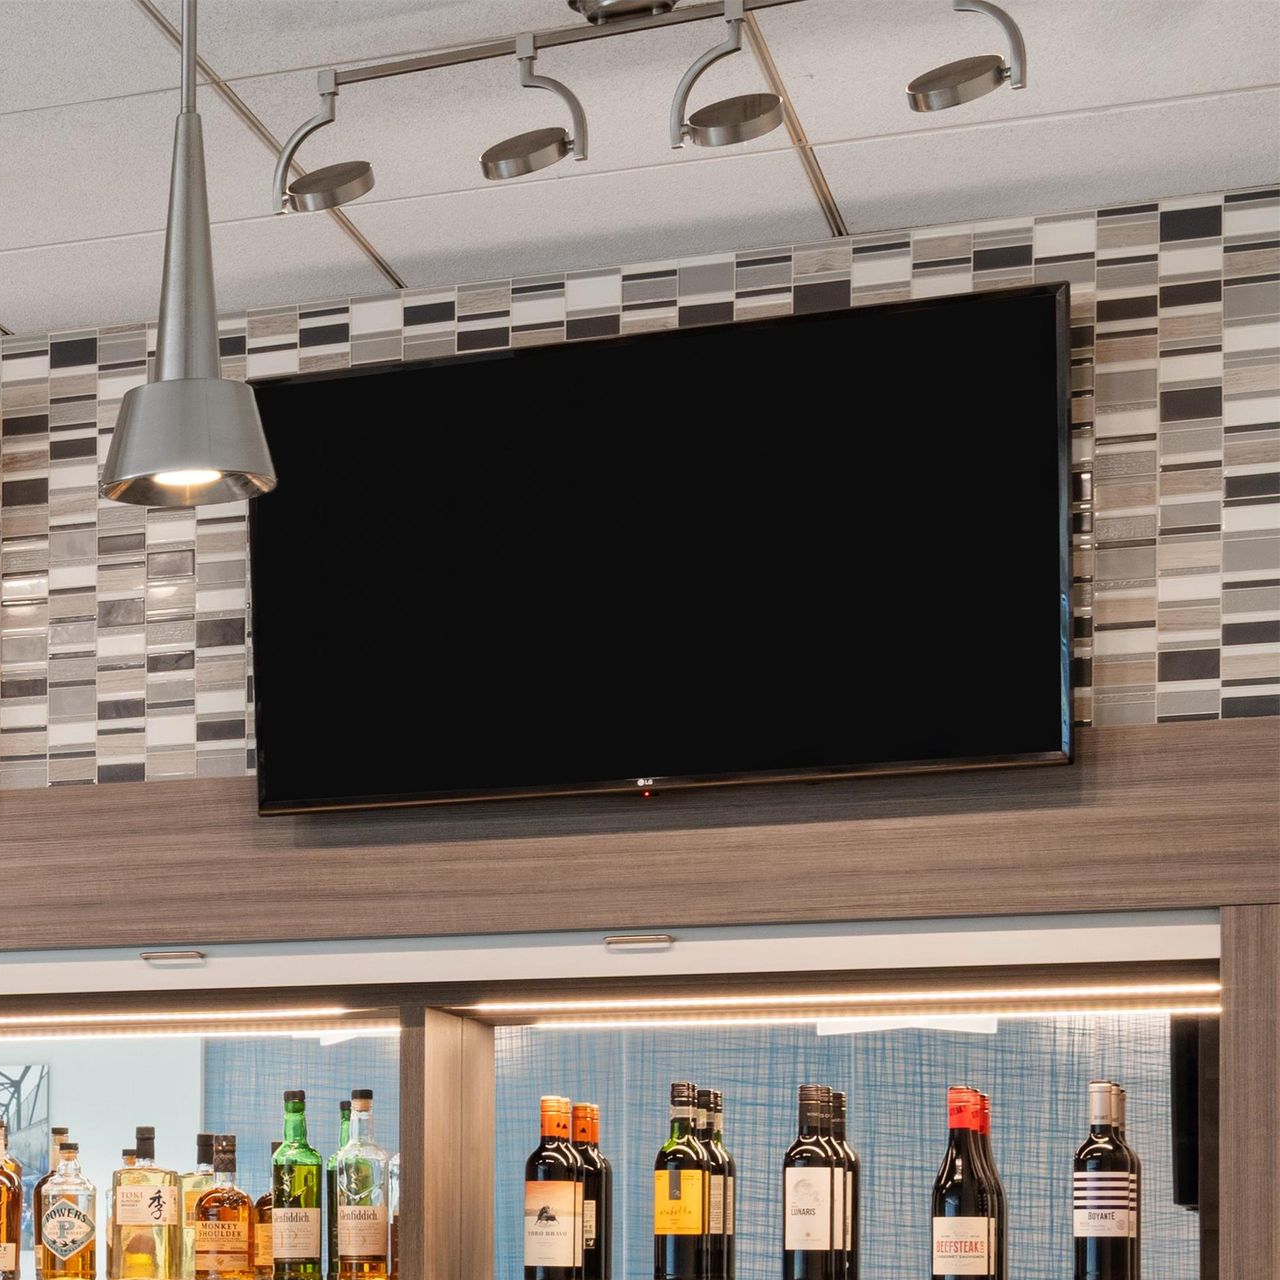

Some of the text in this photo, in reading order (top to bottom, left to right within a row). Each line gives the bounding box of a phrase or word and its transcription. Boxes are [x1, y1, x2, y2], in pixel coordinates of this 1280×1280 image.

[120, 1191, 143, 1199] TOKI
[45, 1207, 88, 1223] POWERS
[790, 1207, 816, 1216] LUNARIS
[201, 1222, 238, 1230] MONKEY
[198, 1230, 241, 1238] SHOULDER
[936, 1240, 979, 1253] BEEFSTEAK
